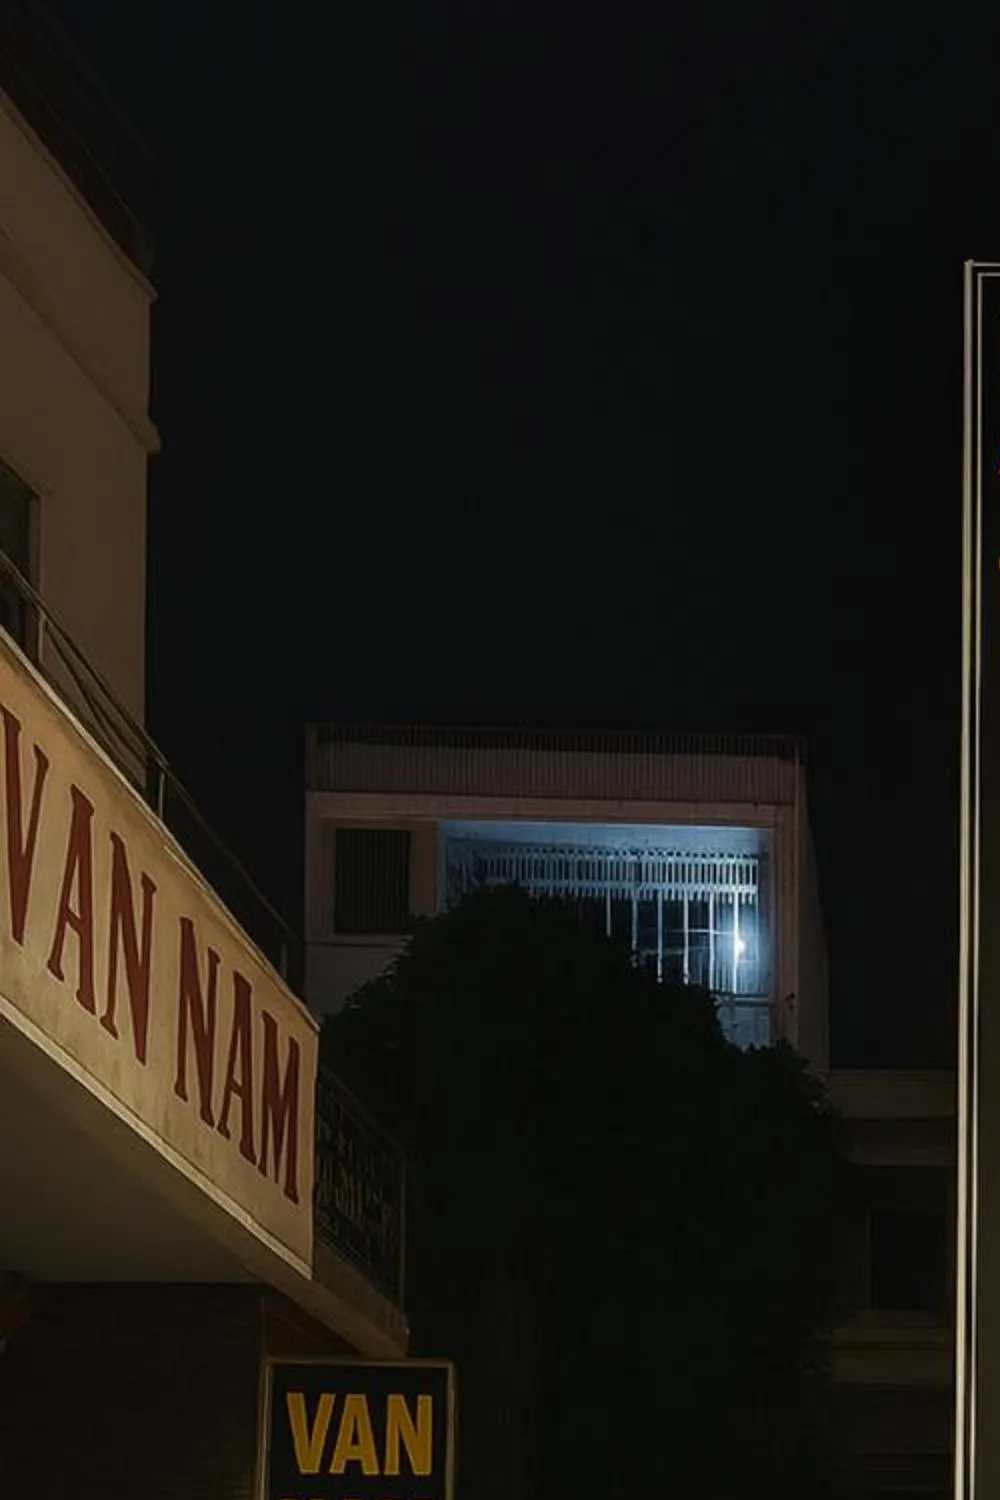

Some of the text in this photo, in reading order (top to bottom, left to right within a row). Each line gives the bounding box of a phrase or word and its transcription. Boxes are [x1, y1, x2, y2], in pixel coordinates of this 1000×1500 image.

[0, 703, 301, 1206] VAN NAM
[286, 1391, 434, 1477] VAN
